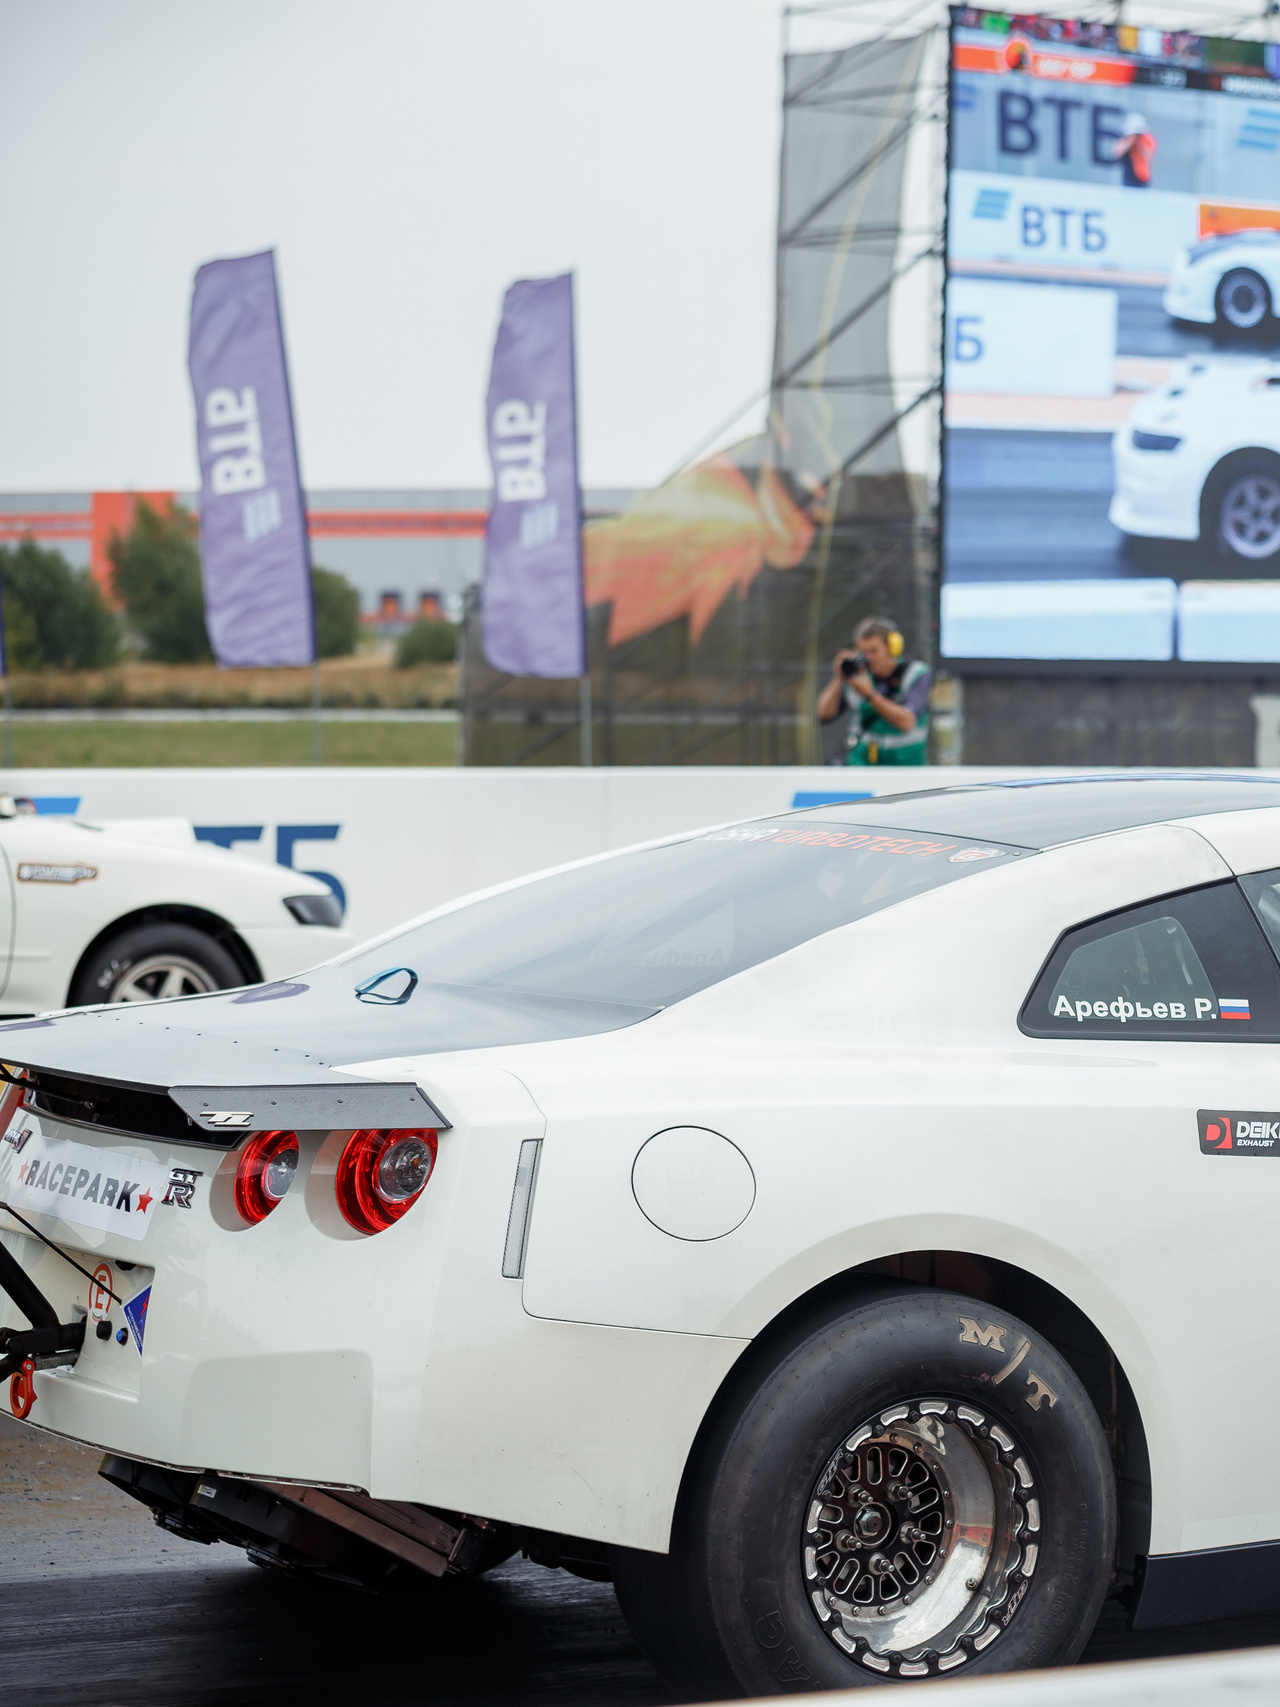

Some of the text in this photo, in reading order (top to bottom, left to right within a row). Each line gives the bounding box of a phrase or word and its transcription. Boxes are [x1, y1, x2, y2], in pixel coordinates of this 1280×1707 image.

[996, 90, 1127, 167] ВТБ
[1019, 205, 1108, 252] ВТБ
[1053, 995, 1217, 1022] Арефьев Р.
[1237, 1139, 1275, 1148] EXHAUST
[25, 1159, 141, 1213] RACEPARK
